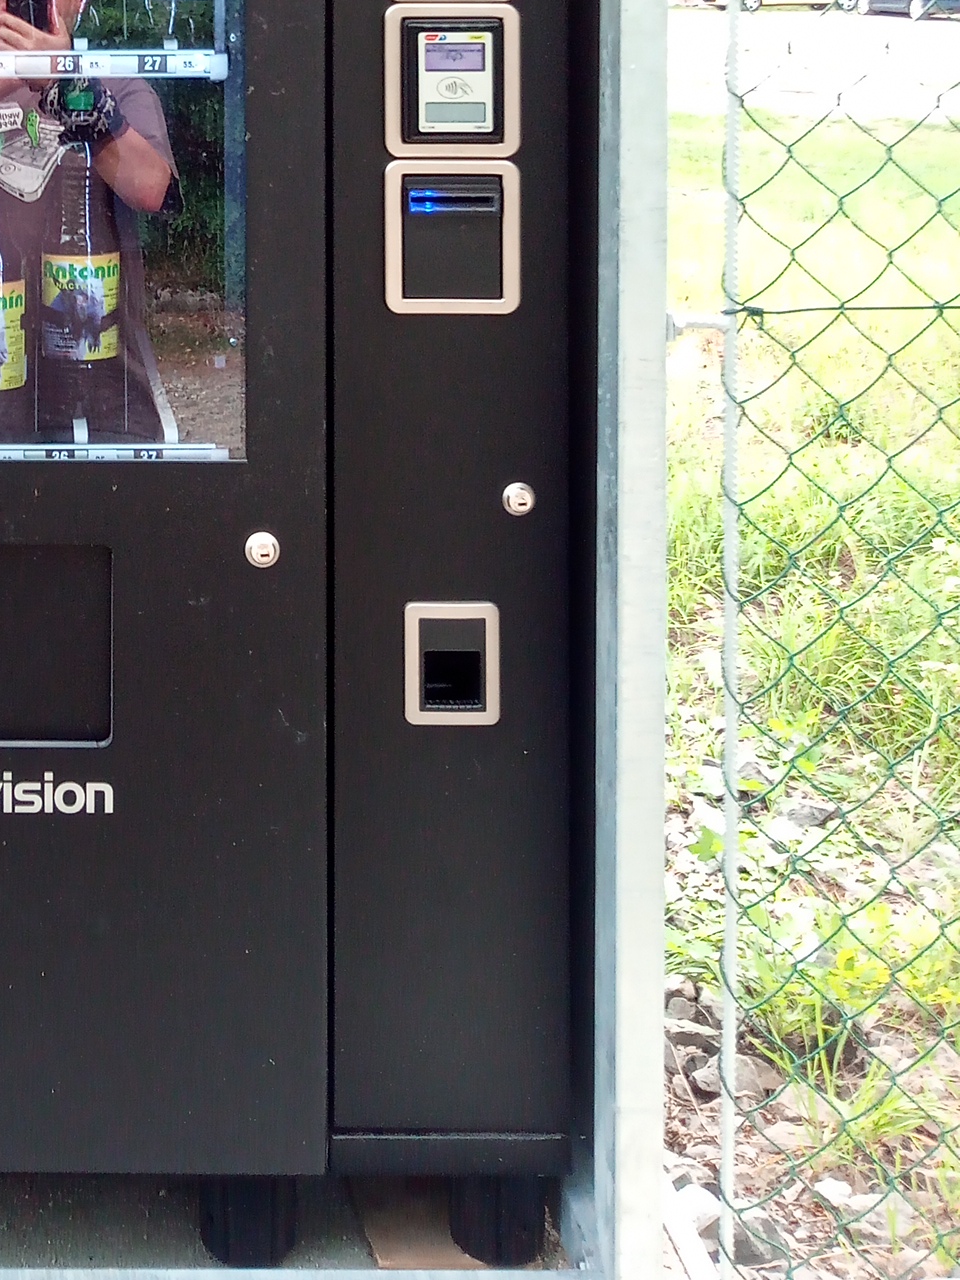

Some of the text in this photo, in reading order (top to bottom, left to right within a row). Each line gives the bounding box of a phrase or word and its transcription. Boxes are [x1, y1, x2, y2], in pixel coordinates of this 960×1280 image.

[56, 56, 74, 72] 26
[144, 56, 162, 71] 27
[44, 259, 119, 280] Antonín
